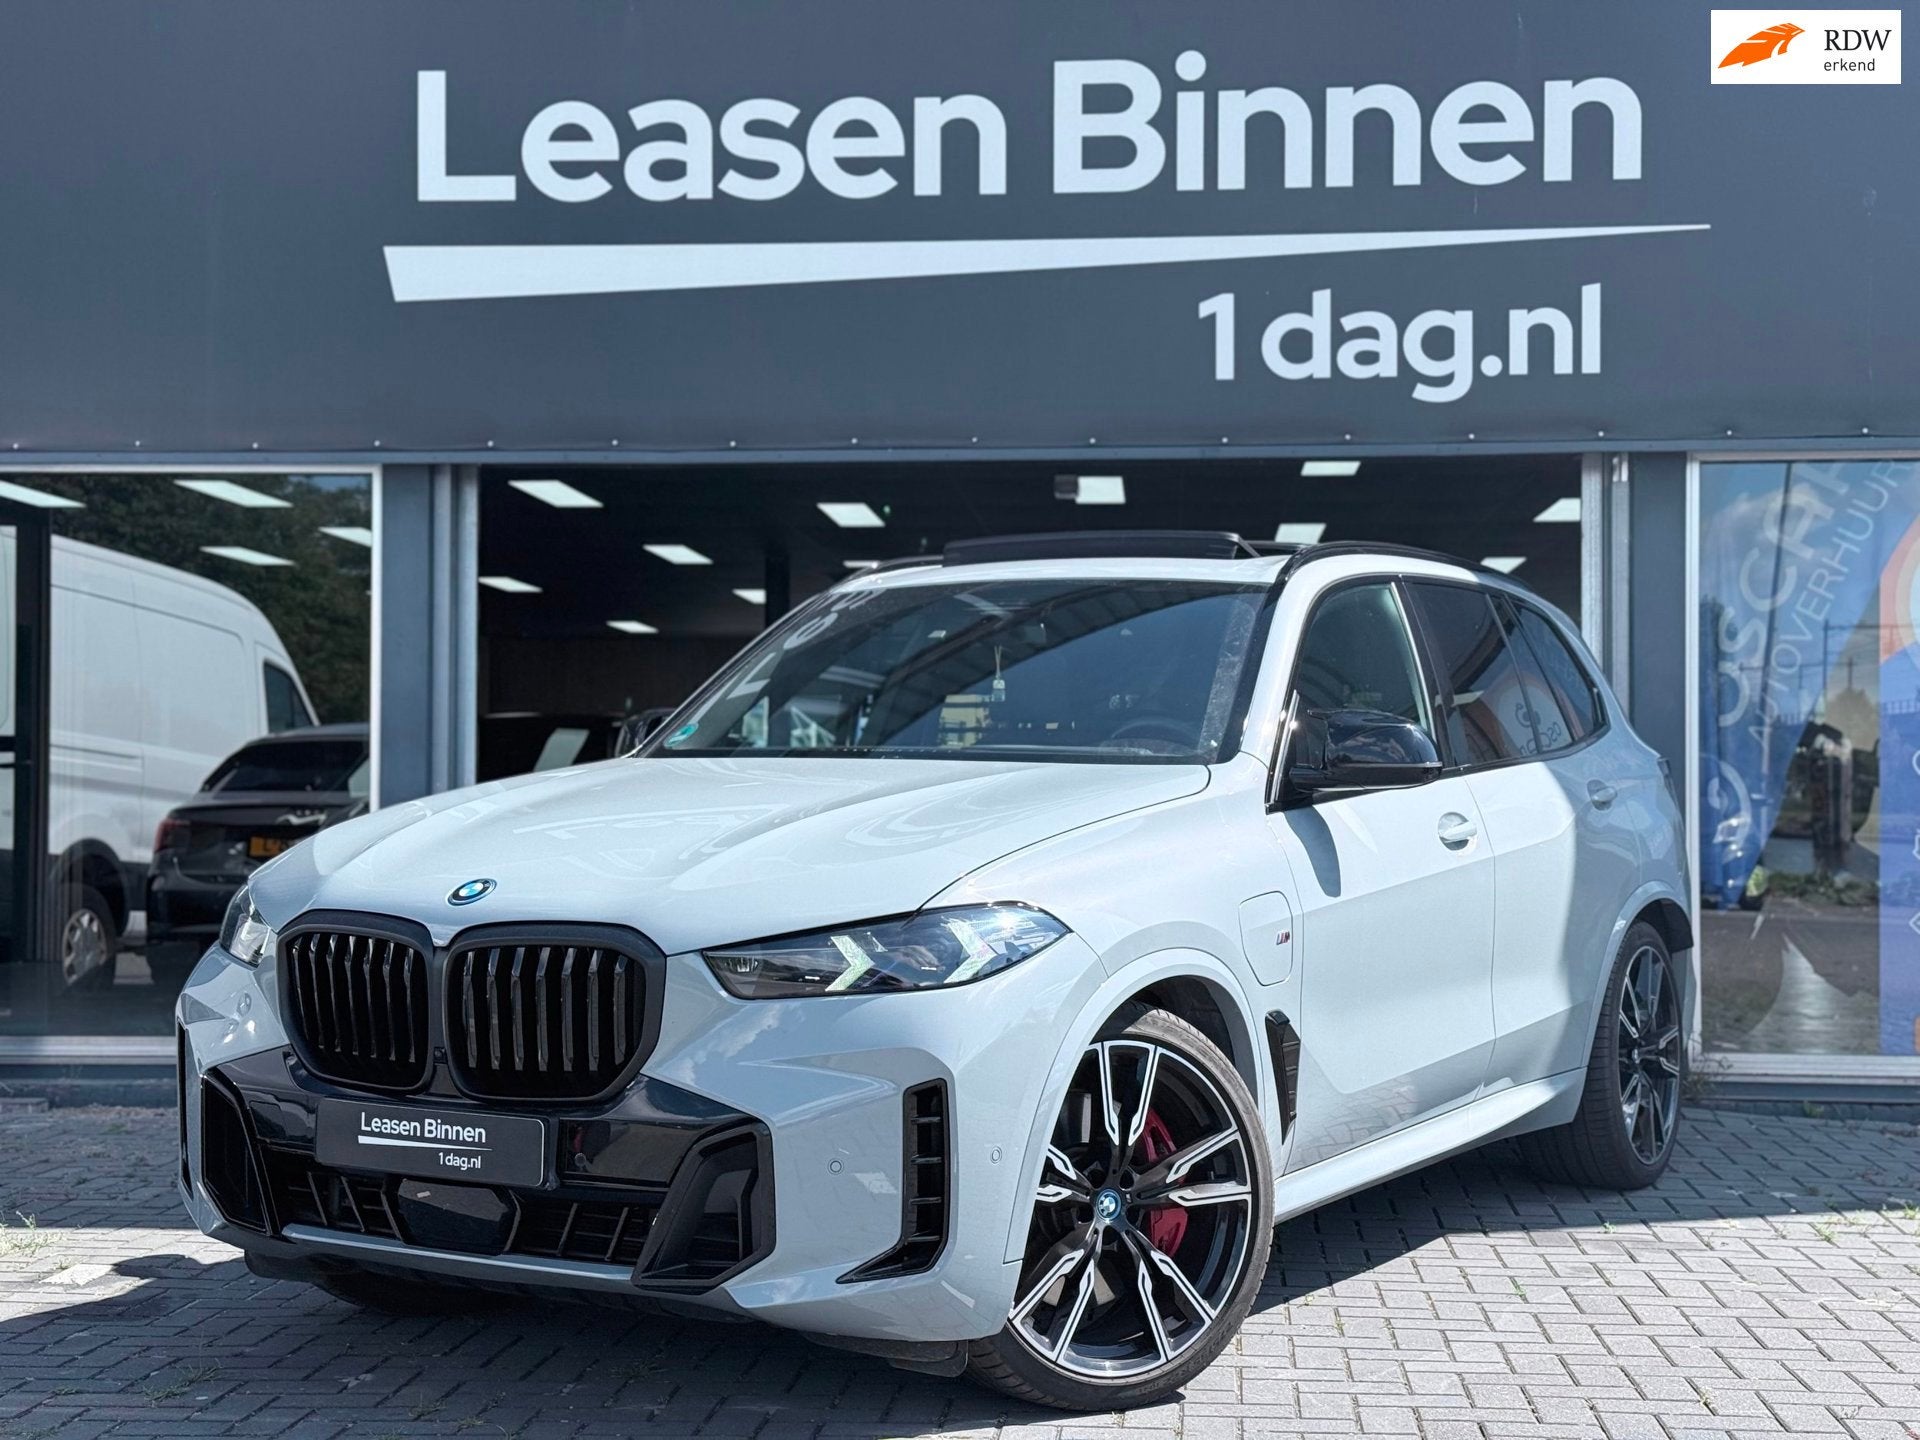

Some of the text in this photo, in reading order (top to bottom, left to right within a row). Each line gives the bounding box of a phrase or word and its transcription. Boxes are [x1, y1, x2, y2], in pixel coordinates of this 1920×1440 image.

[417, 50, 1642, 202] Leasen Binnen
[361, 1111, 486, 1143] Leasen Binnen
